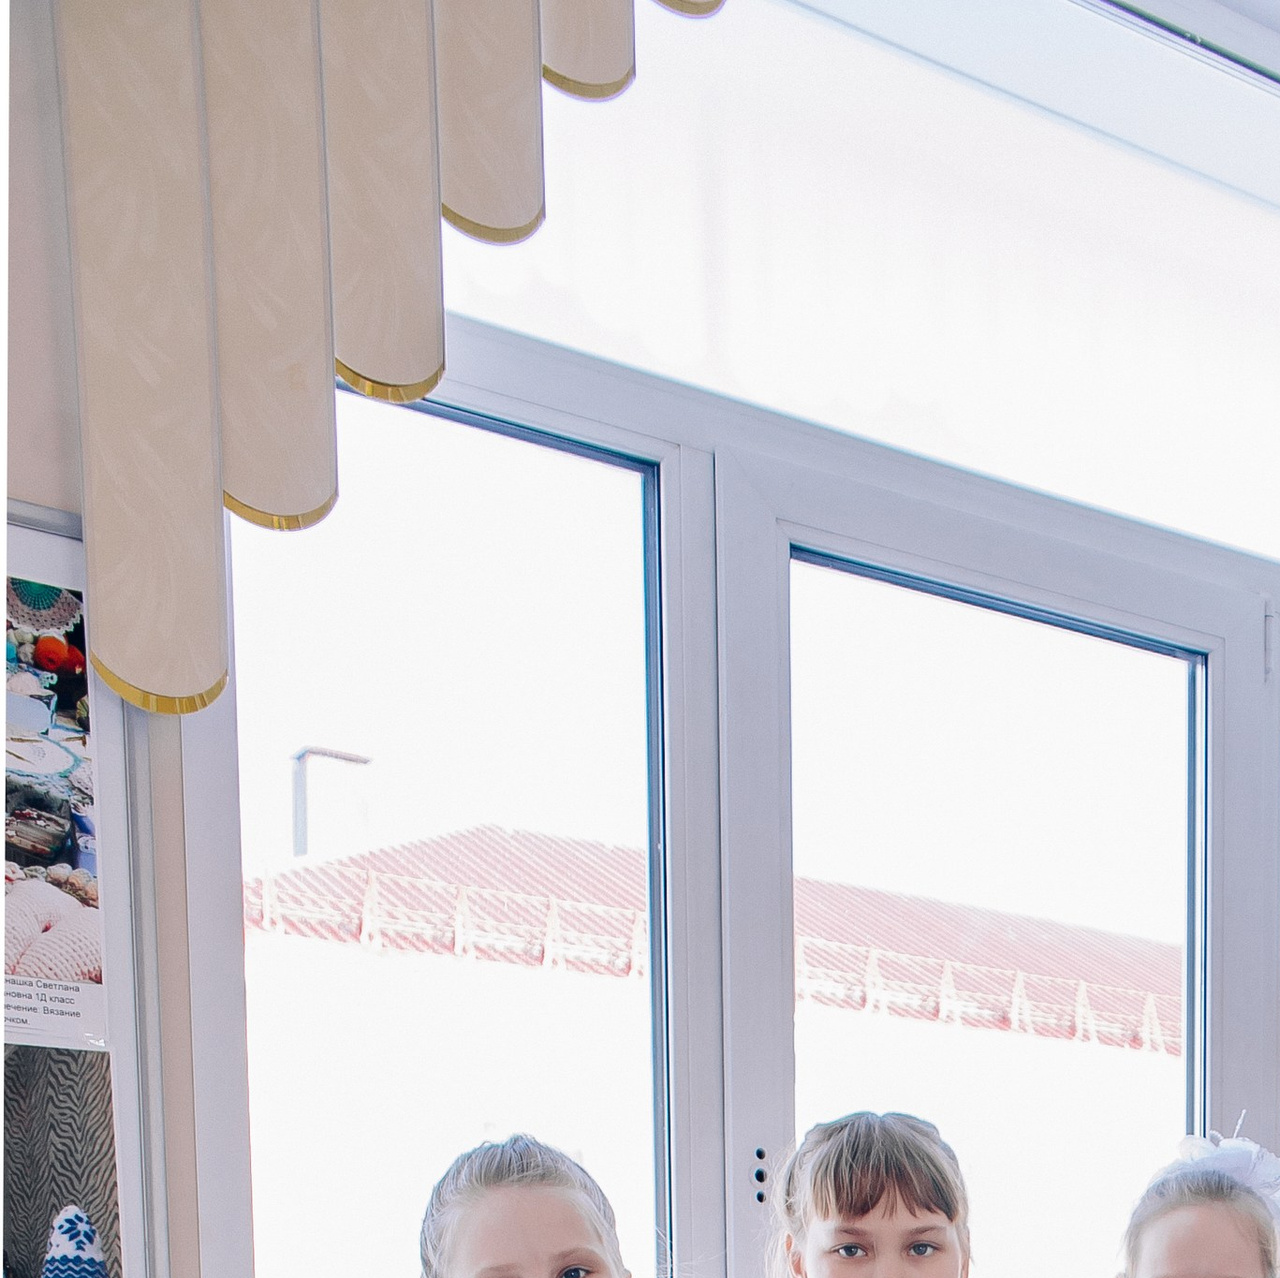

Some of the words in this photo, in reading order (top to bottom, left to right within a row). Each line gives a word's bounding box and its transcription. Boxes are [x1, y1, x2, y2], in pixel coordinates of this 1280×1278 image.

[36, 979, 80, 992] Светлана
[49, 996, 75, 1004] класс
[43, 1006, 81, 1018] Вязание
